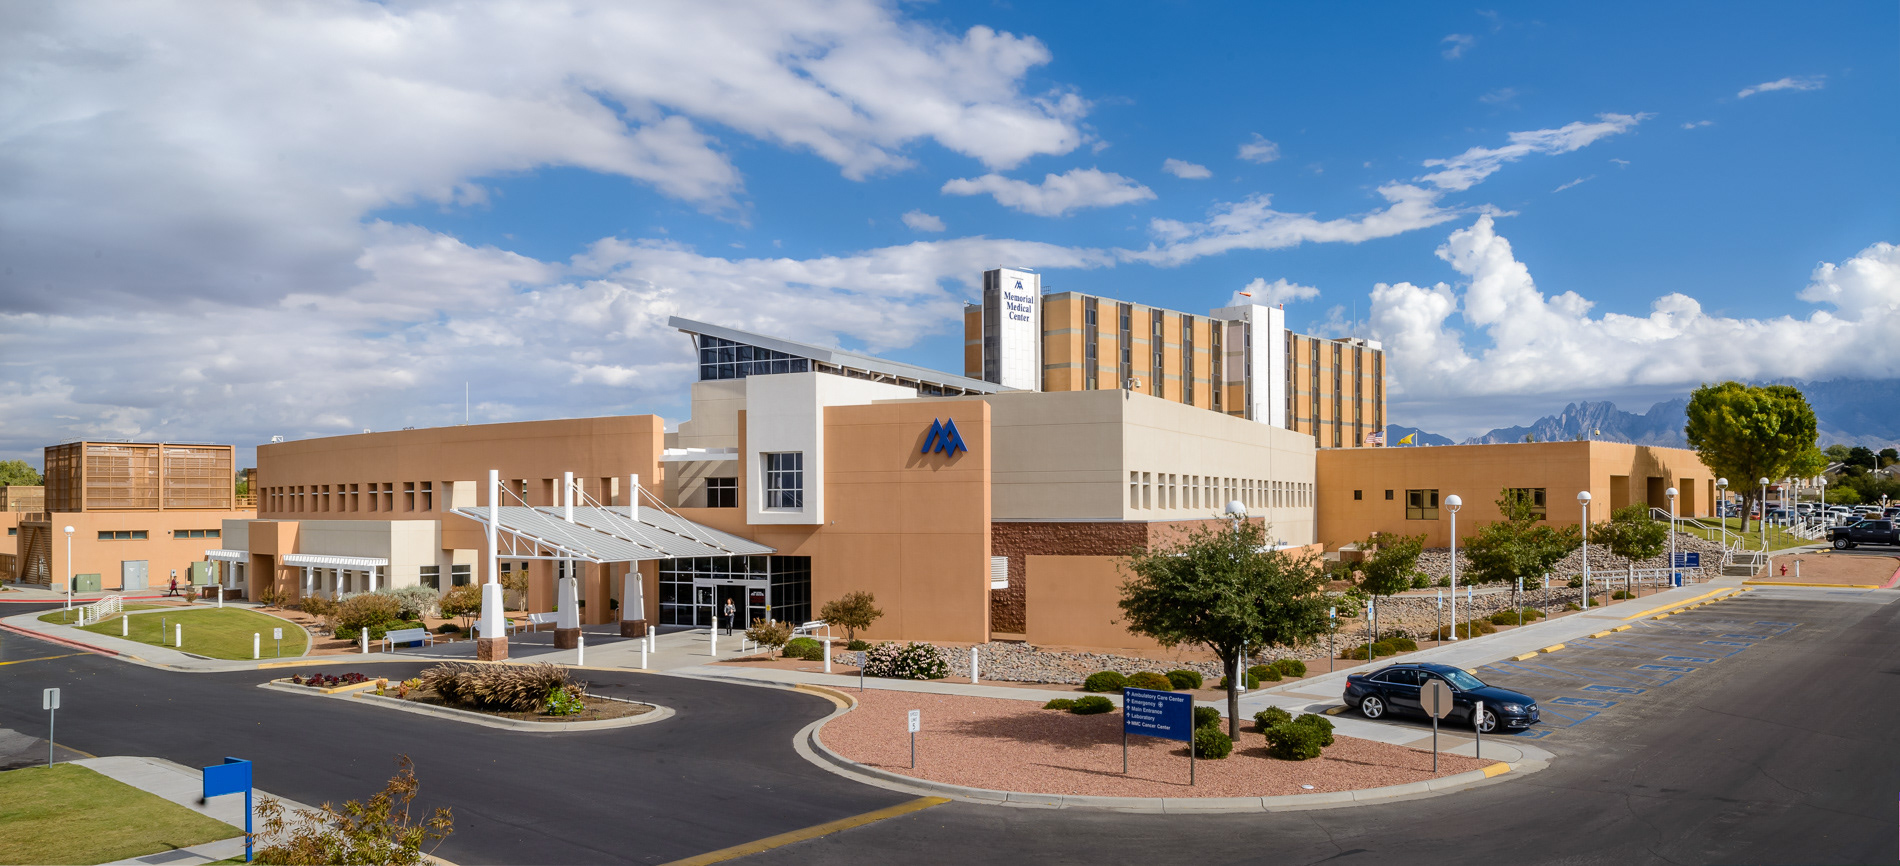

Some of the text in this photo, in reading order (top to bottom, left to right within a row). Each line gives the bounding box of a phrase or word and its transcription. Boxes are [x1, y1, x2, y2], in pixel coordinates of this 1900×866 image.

[1004, 291, 1033, 304] Memorial
[1007, 302, 1031, 313] Medical
[1009, 311, 1029, 322] Center
[1131, 692, 1156, 700] Ambulatory
[1131, 699, 1156, 707] Emergency
[1131, 713, 1155, 721] Laboratory
